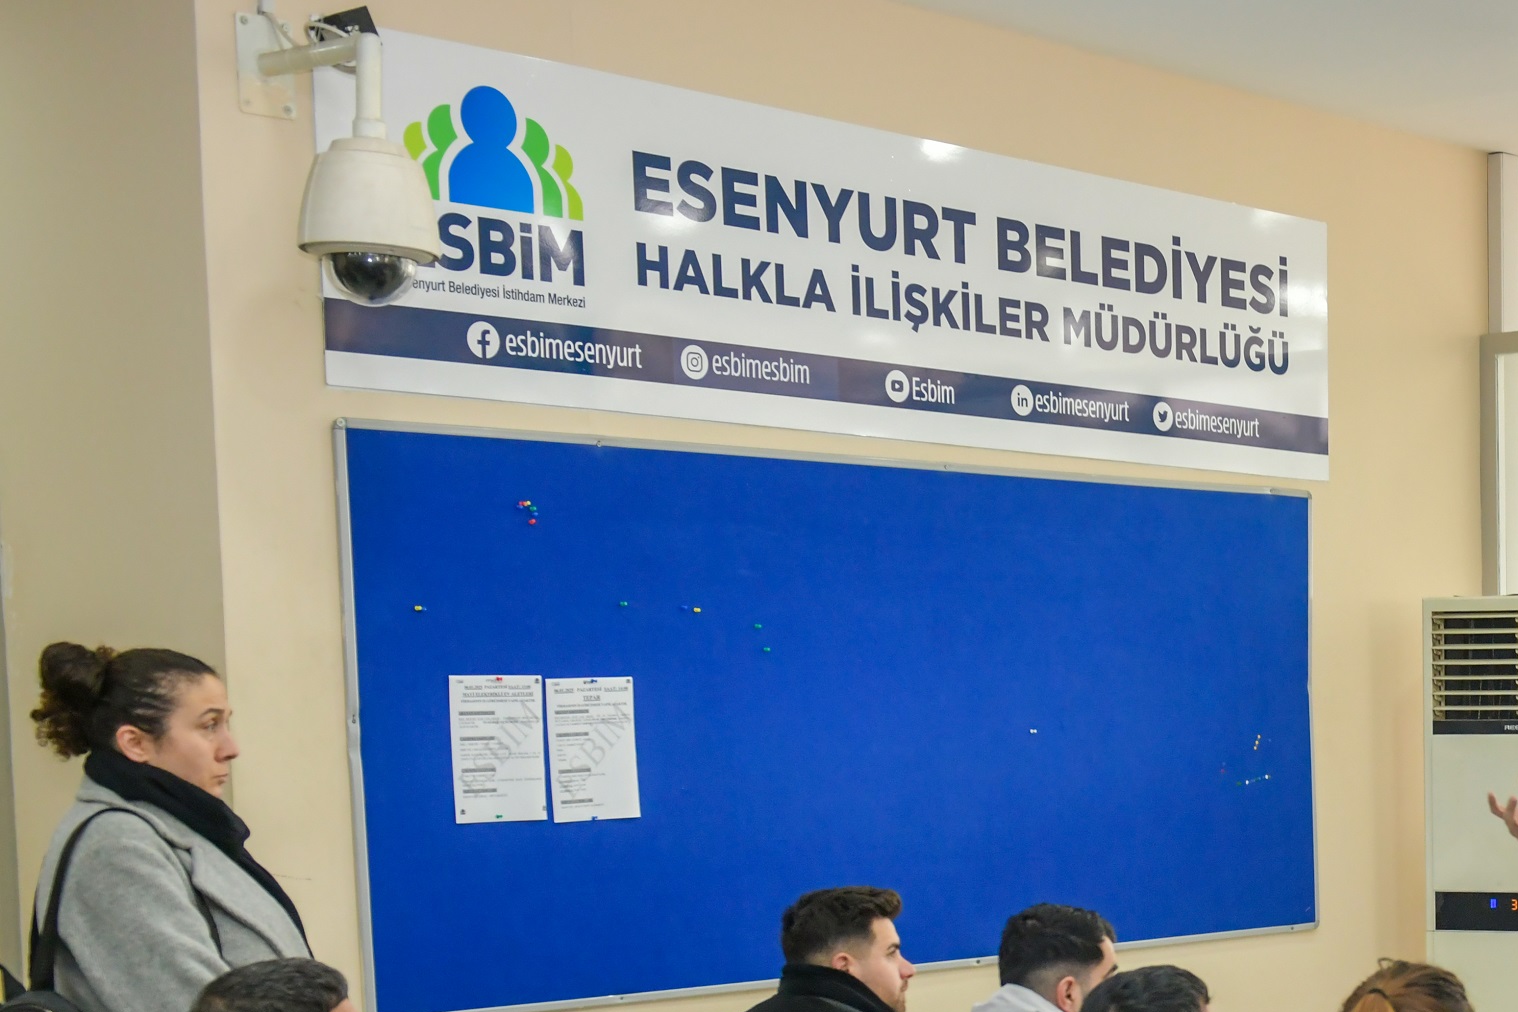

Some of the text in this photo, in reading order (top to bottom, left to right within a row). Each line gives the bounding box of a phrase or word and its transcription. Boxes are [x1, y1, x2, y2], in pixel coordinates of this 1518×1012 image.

[417, 212, 586, 287] SBİM
[632, 150, 1289, 318] ESENYURT BELEDİYESİ
[412, 279, 586, 309] enyurt Belediyesi İstihdam Merkezi
[636, 242, 1290, 376] HALKLA İLİŞKİLER MÜDÜRLÜĞÜ
[505, 330, 643, 369] esbimesenyurt
[711, 351, 811, 385] esbimesbim
[911, 377, 956, 405] Esbim
[1034, 391, 1130, 423] esbimesenyurt
[1175, 408, 1260, 438] esbimesenyurt
